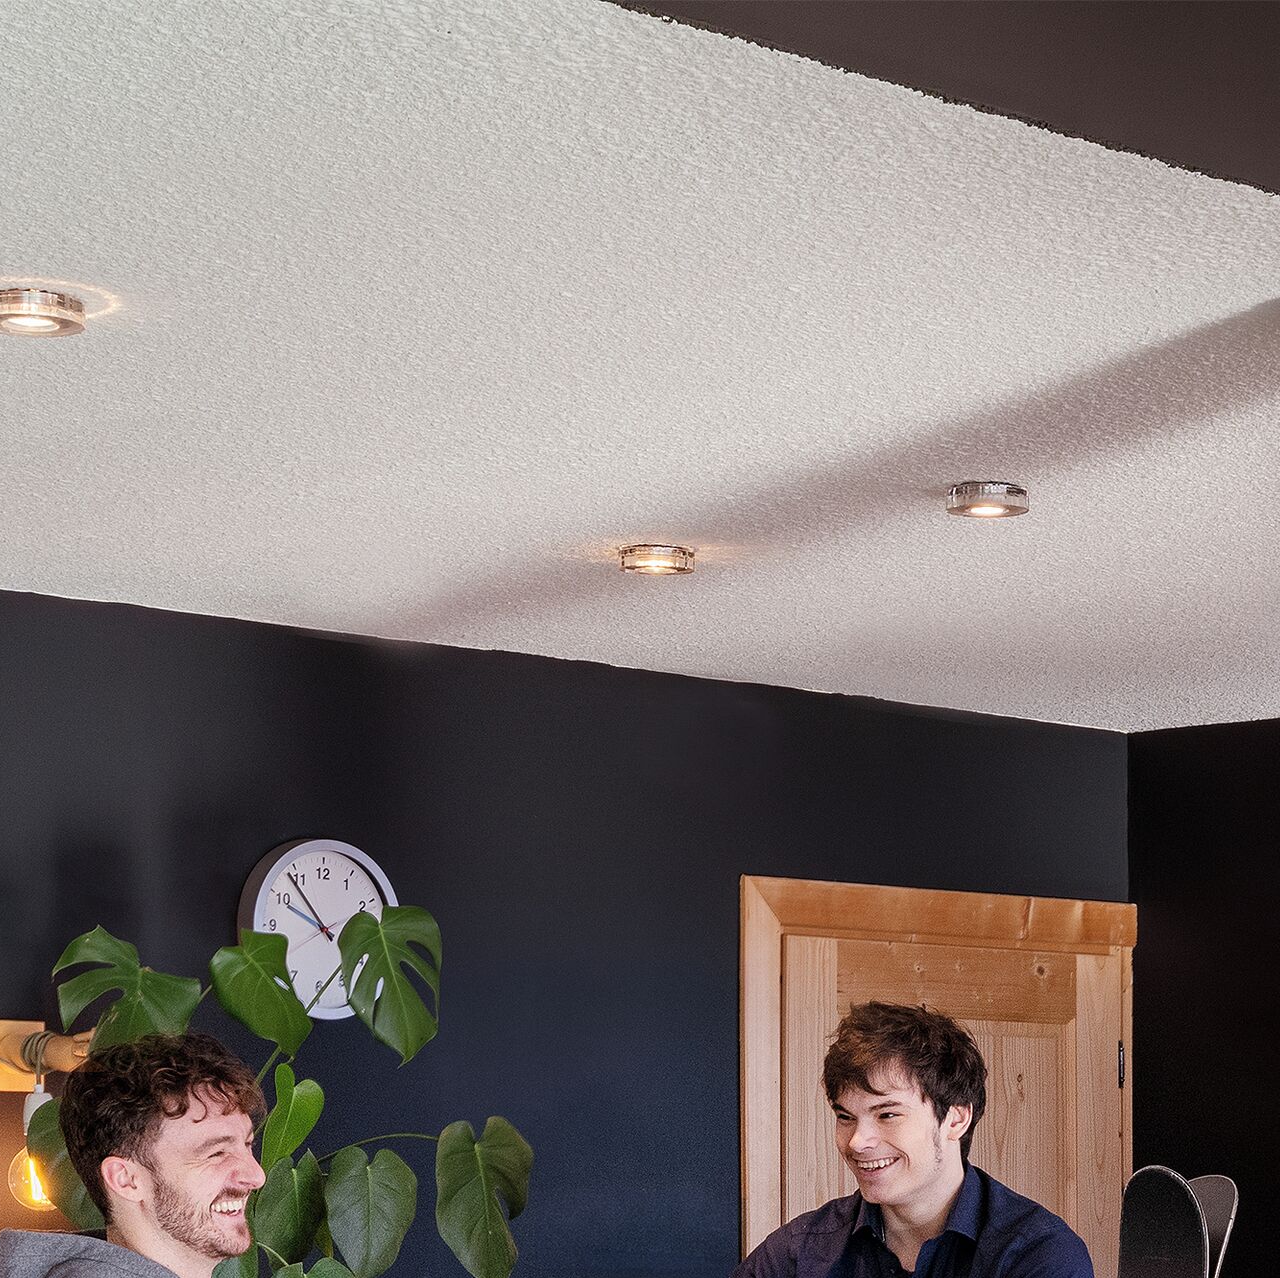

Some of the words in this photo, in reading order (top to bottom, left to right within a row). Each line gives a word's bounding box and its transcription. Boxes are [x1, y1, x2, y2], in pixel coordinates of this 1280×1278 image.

[316, 868, 330, 881] 12
[343, 878, 349, 890] 1
[276, 893, 291, 905] 10
[358, 901, 366, 912] 2
[269, 919, 277, 931] 9
